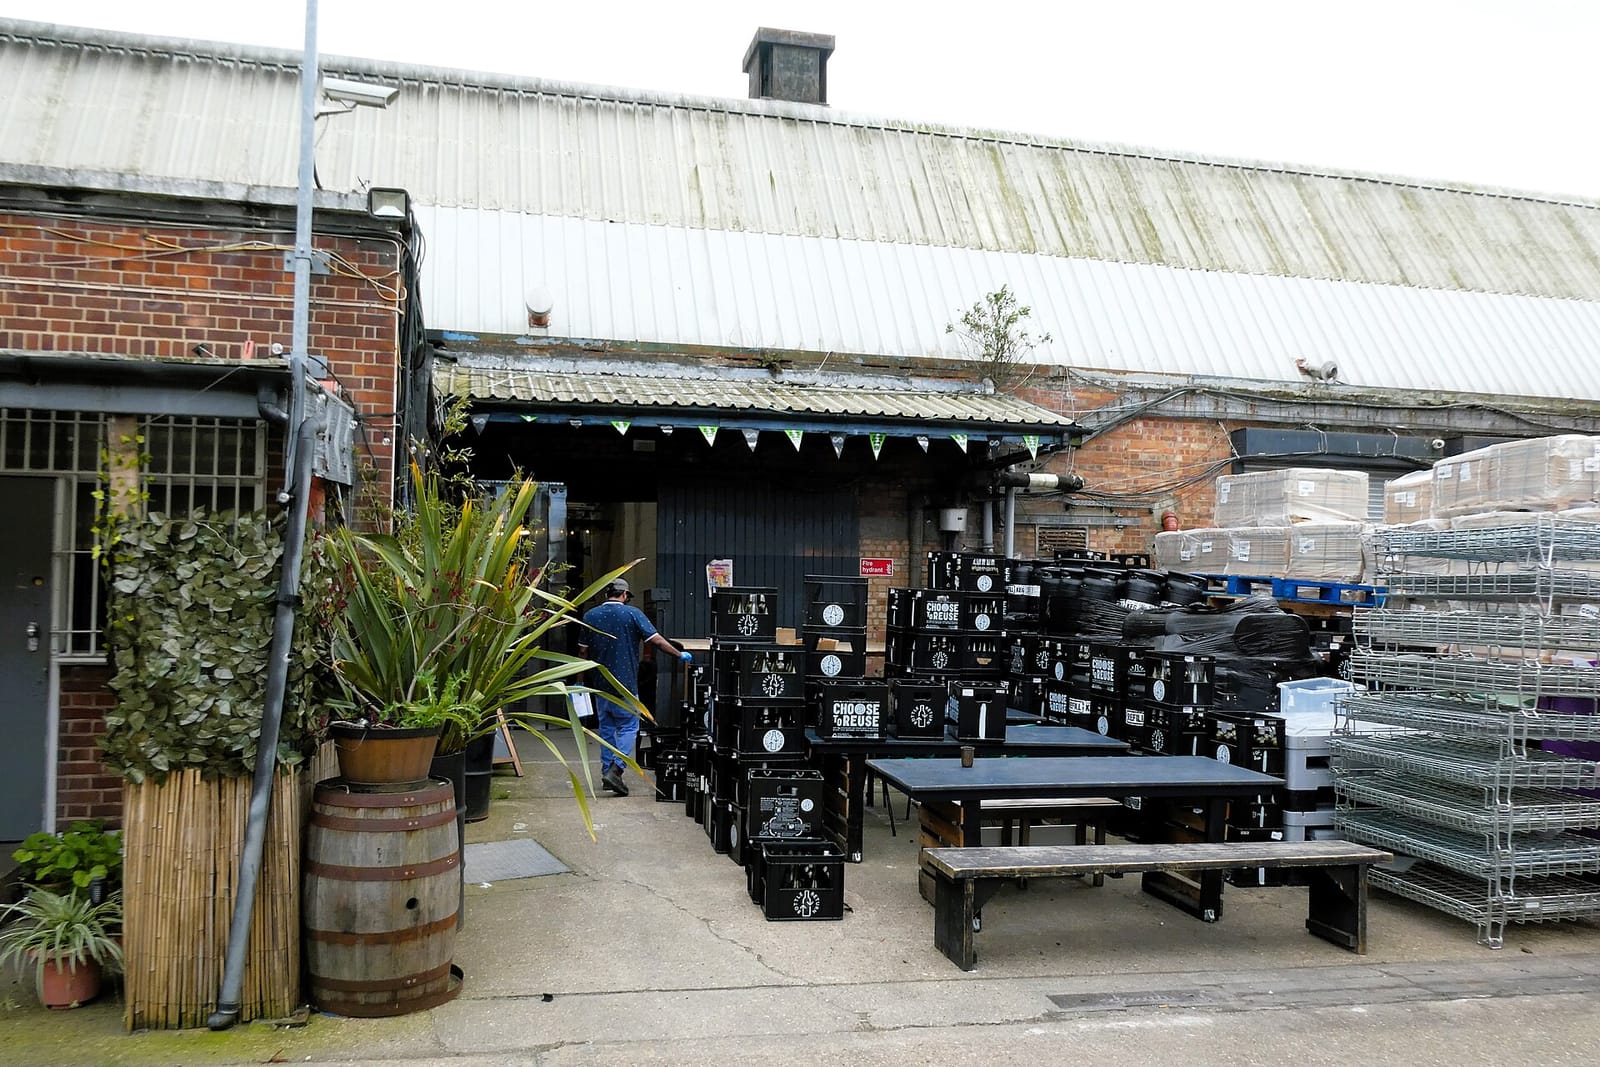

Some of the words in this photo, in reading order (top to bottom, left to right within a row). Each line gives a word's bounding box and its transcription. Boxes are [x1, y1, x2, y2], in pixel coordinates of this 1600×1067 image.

[926, 602, 959, 613] CHOOSE
[933, 611, 958, 620] REUSE
[833, 703, 880, 715] CHOOSE
[842, 715, 880, 727] REUSE
